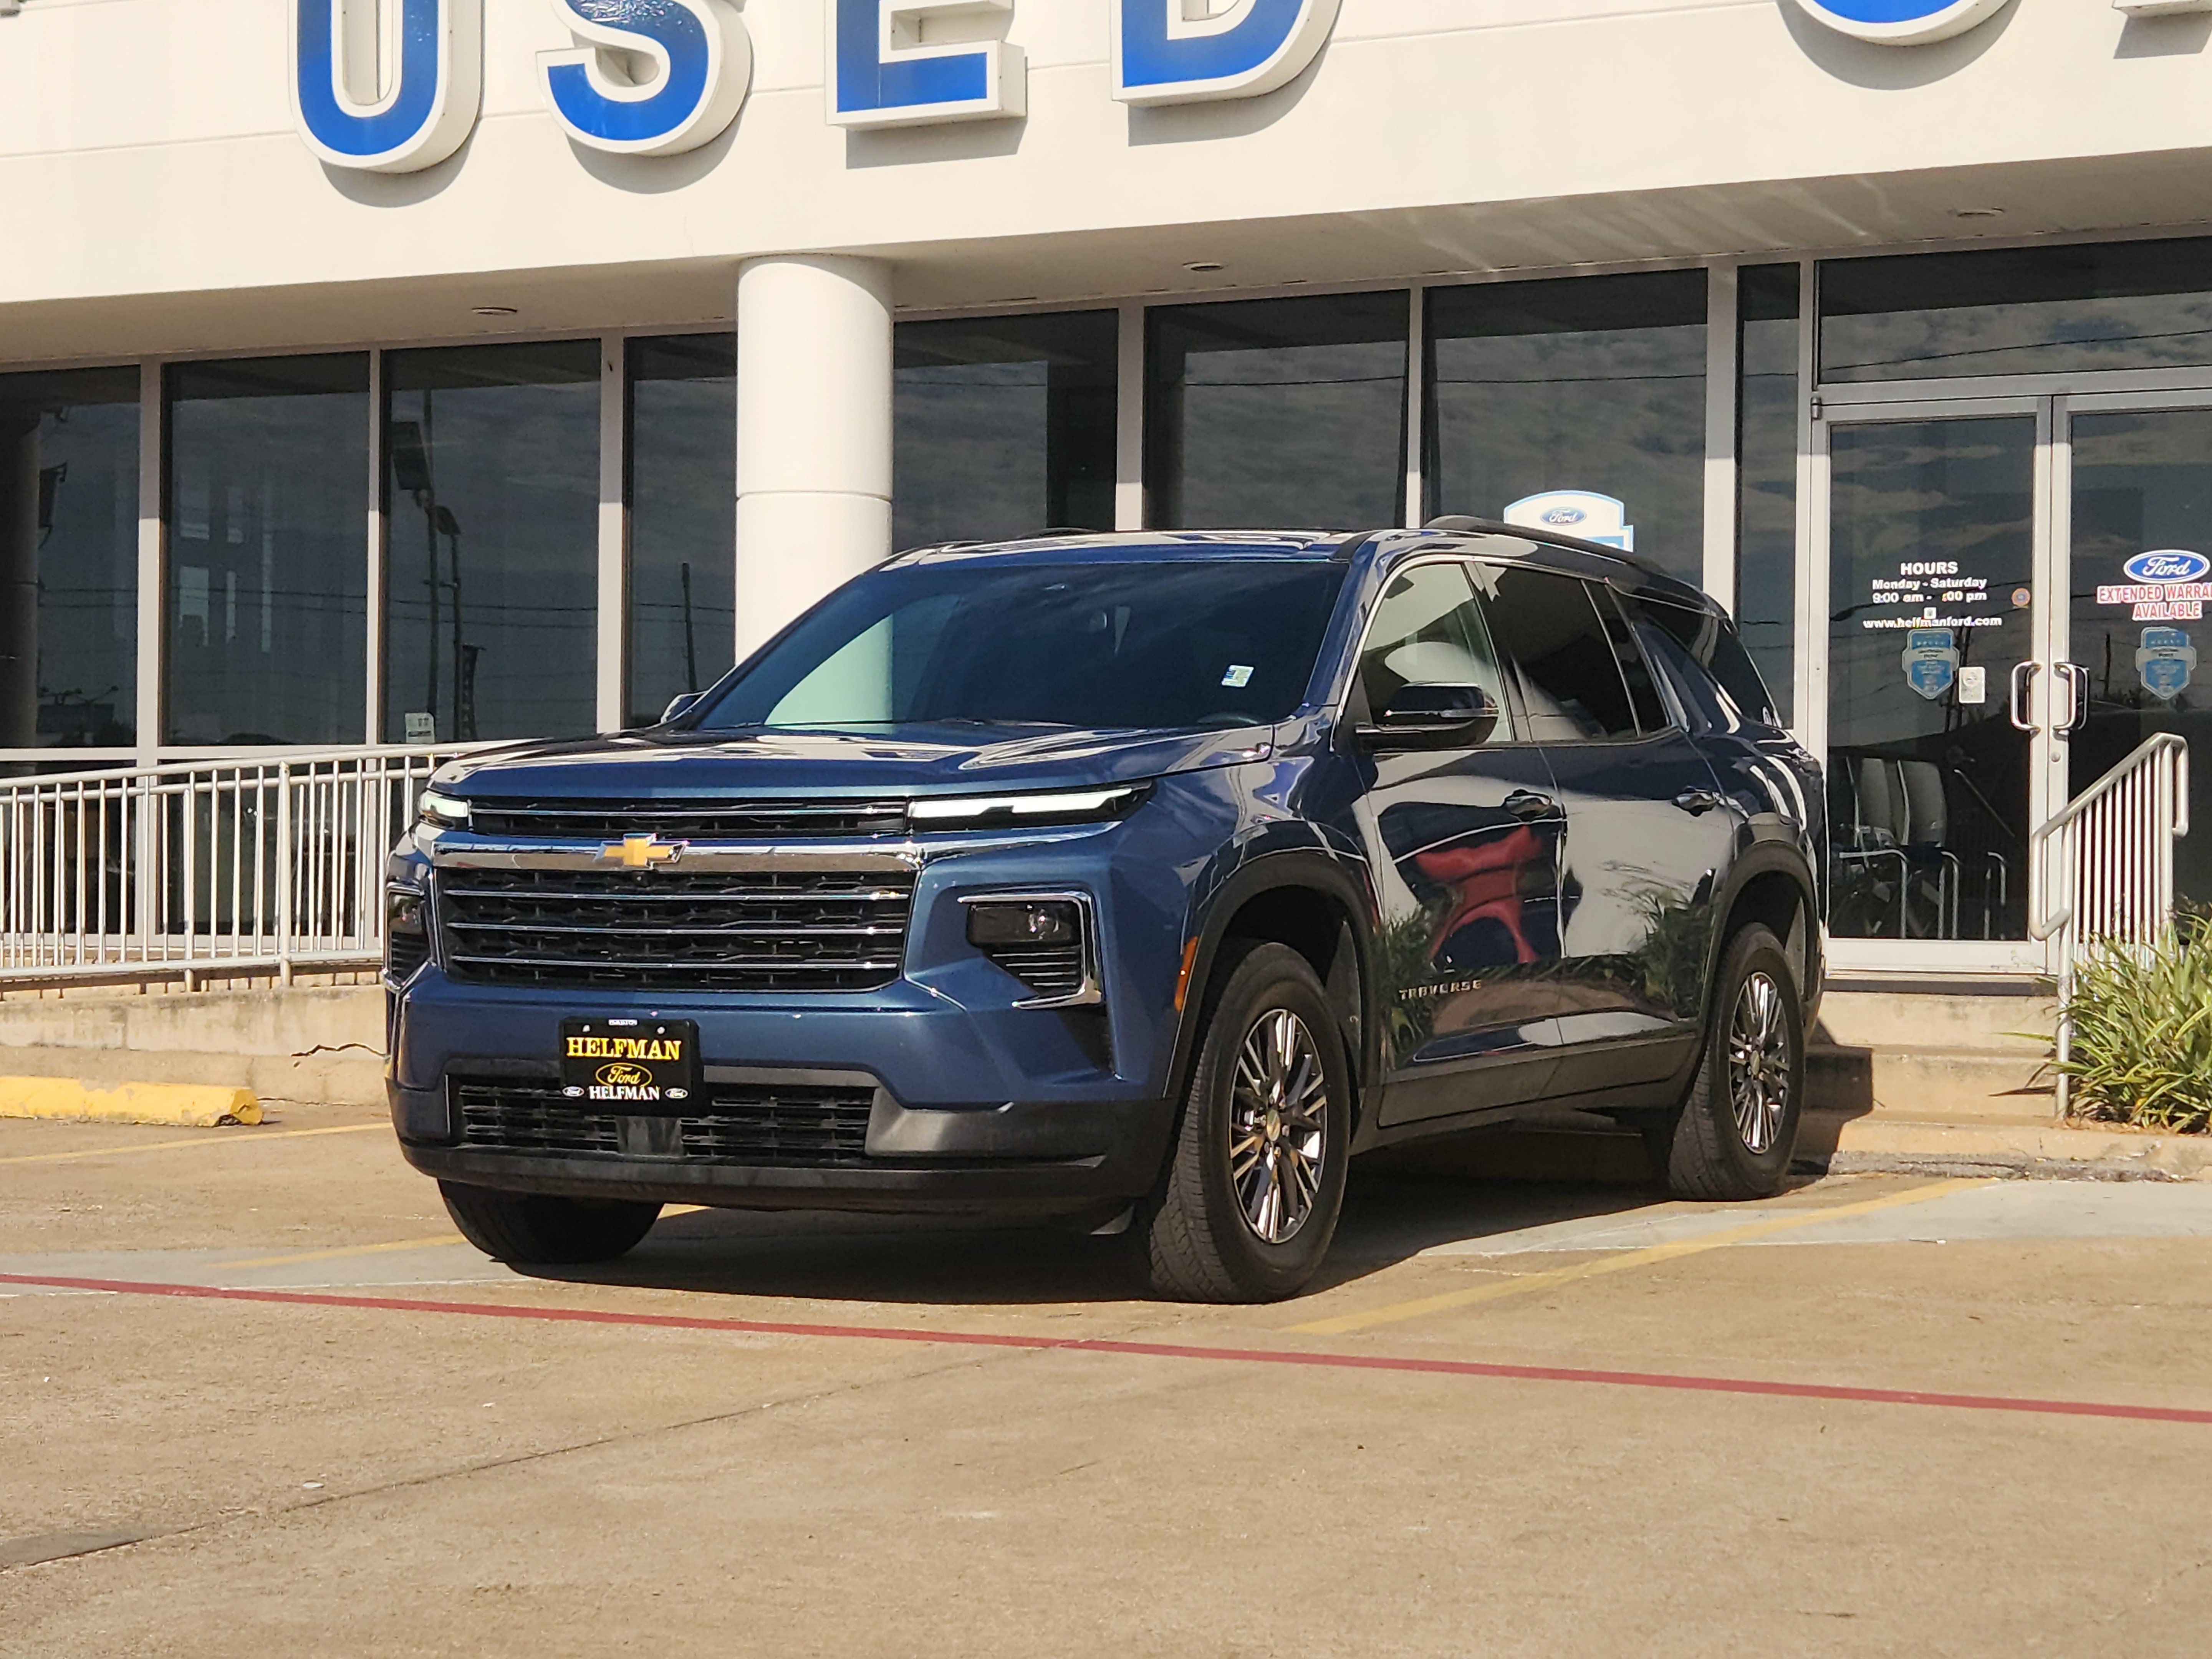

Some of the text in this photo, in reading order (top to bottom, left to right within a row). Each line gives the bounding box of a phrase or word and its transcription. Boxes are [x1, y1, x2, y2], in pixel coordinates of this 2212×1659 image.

[1549, 509, 1578, 523] Ford
[1901, 561, 1959, 575] HOURS
[2142, 557, 2191, 576] Ford
[1872, 579, 1921, 590] Monday
[1930, 577, 1987, 590] Saturday
[2098, 583, 2212, 602] EXTENDED WARRA
[1902, 594, 1924, 602] am
[1966, 592, 1987, 603] pm
[2134, 602, 2202, 620] AVAILABLE
[1399, 979, 1482, 1000] TRAVERSE
[566, 1037, 681, 1060] HELFMAN
[607, 1065, 641, 1085] Ford
[589, 1086, 660, 1100] HELFMAN
